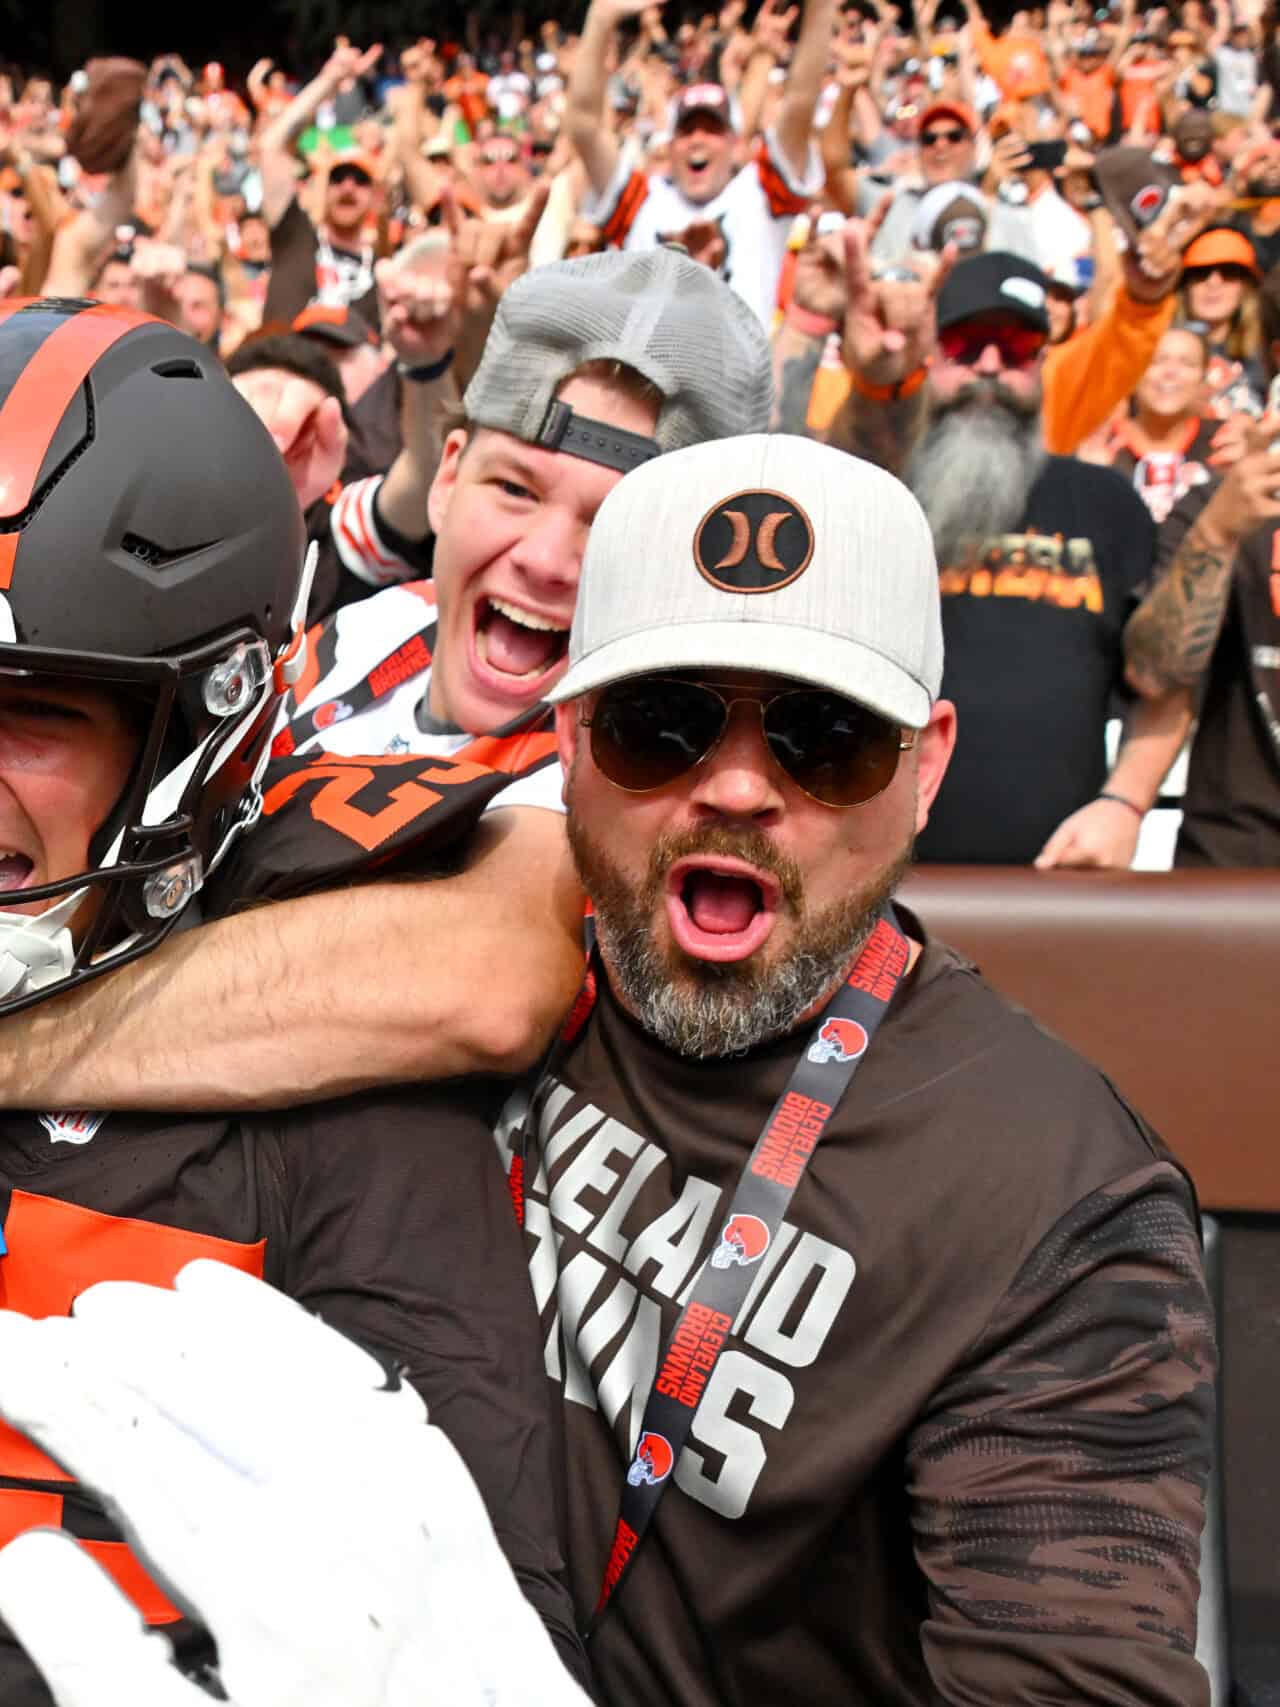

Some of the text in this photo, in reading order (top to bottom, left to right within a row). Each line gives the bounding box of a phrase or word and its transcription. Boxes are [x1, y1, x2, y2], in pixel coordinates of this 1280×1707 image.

[752, 1091, 810, 1180] BROWNS
[776, 1101, 832, 1189] CLEVELAND
[656, 1301, 713, 1398] BROWNS
[678, 1311, 732, 1408] CLEVELAND
